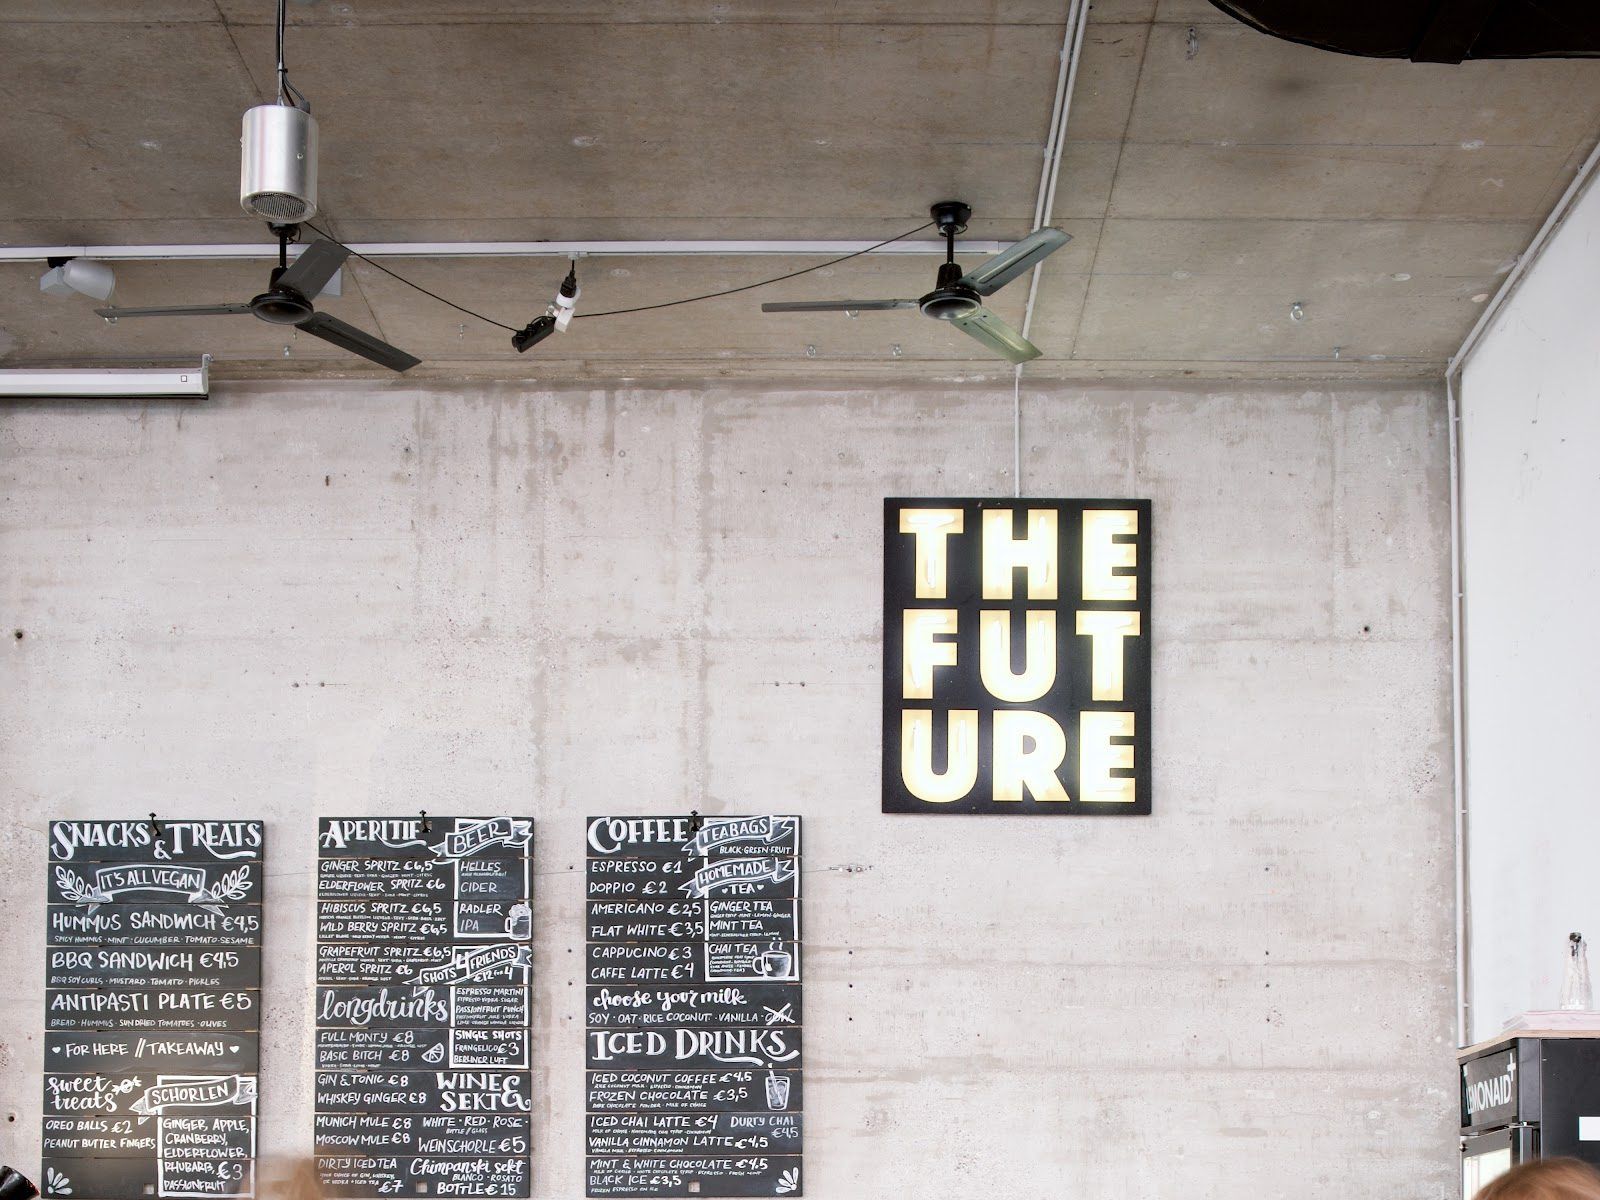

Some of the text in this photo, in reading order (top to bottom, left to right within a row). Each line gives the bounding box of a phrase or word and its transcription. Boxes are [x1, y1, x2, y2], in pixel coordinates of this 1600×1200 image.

[899, 509, 1138, 600] THE
[902, 609, 1141, 703] FUT
[901, 709, 1135, 803] URE
[319, 820, 426, 848] APERITIF
[588, 817, 689, 853] COFFEE
[701, 819, 768, 843] TEABAGS
[51, 822, 261, 860] SNACKS TREATS
[454, 821, 509, 854] BEER
[720, 846, 791, 854] BLACK GREEN FRUIT
[321, 860, 400, 872] GINGER SPRITZ
[461, 861, 500, 873] HELLES
[592, 861, 682, 873] ESPRESSO €1
[700, 859, 770, 884] HOMEMADE
[101, 870, 201, 889] IT'S ALL VEGAN
[319, 879, 423, 892] ELDERFLOWER SPRITZ
[461, 882, 497, 892] CIDER
[590, 881, 667, 894] DOPPIO €2
[729, 883, 755, 894] TEA
[322, 903, 408, 913] HIBISCUS SPRITZ
[460, 903, 503, 916] RADLER
[592, 903, 664, 914] AMERICANO
[710, 901, 772, 913] GINGER TEA
[53, 911, 216, 933] HUMMUS SANDWICH
[320, 922, 416, 932] WILD BERRY SPRITZ
[461, 919, 478, 932] IPA
[710, 920, 763, 930] MINT TEA
[592, 924, 666, 937] FLAT WHITE
[134, 936, 180, 944] CUCUMBER
[320, 946, 422, 957] GRAPEFRUIT SPRITZ
[593, 947, 691, 960] CAPPUCINO €3
[709, 944, 758, 955] CHAI TEA
[52, 951, 192, 971] BBQ SANDWICH
[423, 948, 516, 983] SHOTS FRIENDS
[320, 963, 391, 974] APEROL SPRITZ
[592, 964, 694, 979] CAFFE LATTE €4
[494, 988, 523, 996] MARTINI
[51, 993, 251, 1011] ANTIPASTI PLATE €5
[593, 988, 747, 1011] choose your milk
[318, 987, 448, 1025] longdrinks
[456, 1005, 501, 1013] PASSIONFRUIT
[81, 1019, 113, 1027] HUMMUS
[589, 1013, 758, 1024] SOY OAT RICE COCONUT VANILLA
[322, 1032, 387, 1043] FULL MONTY
[455, 1030, 521, 1041] SINGLE SHOTS
[66, 1042, 223, 1057] FOR HERE TAKEAWAY
[591, 1029, 800, 1066] ICED DRINKS
[320, 1050, 382, 1062] BASIC BITCH
[318, 1074, 384, 1086] GIN TONIC
[436, 1073, 501, 1091] WINE
[592, 1073, 717, 1085] ICED COCONUT COFFEE
[152, 1082, 228, 1105] SCHORLEN
[318, 1093, 406, 1105] WHISKEY GINGER
[590, 1090, 708, 1101] FROZEN CHOCOLATE
[440, 1092, 501, 1112] SEKT
[46, 1121, 107, 1132] OREO BALLS
[213, 1119, 249, 1134] APPLE,
[317, 1116, 389, 1128] MUNICH MULE
[423, 1116, 486, 1127] WHITE RED
[591, 1115, 718, 1129] ICED CHAI LATTE €4
[769, 1116, 793, 1125] CHAI
[44, 1138, 155, 1149] PEANUT BUTTER FINGERS
[165, 1133, 227, 1145] CRANBERRY,
[316, 1135, 389, 1146] MOSCOW MULE
[419, 1136, 525, 1153] WEINSCHORLE €5
[589, 1136, 733, 1147] VANILLA CINNAMON LATTE
[354, 1158, 396, 1169] ICED TEA
[410, 1158, 526, 1176] Chimpanski sekt
[591, 1159, 732, 1169] MINT & WHITE CHOCOLATE
[165, 1161, 242, 1180] RHUBARB, €3
[164, 1180, 225, 1191] PASSIONFRUIT
[590, 1175, 647, 1185] BLACK ICE
[437, 1182, 484, 1194] BOTTLE
